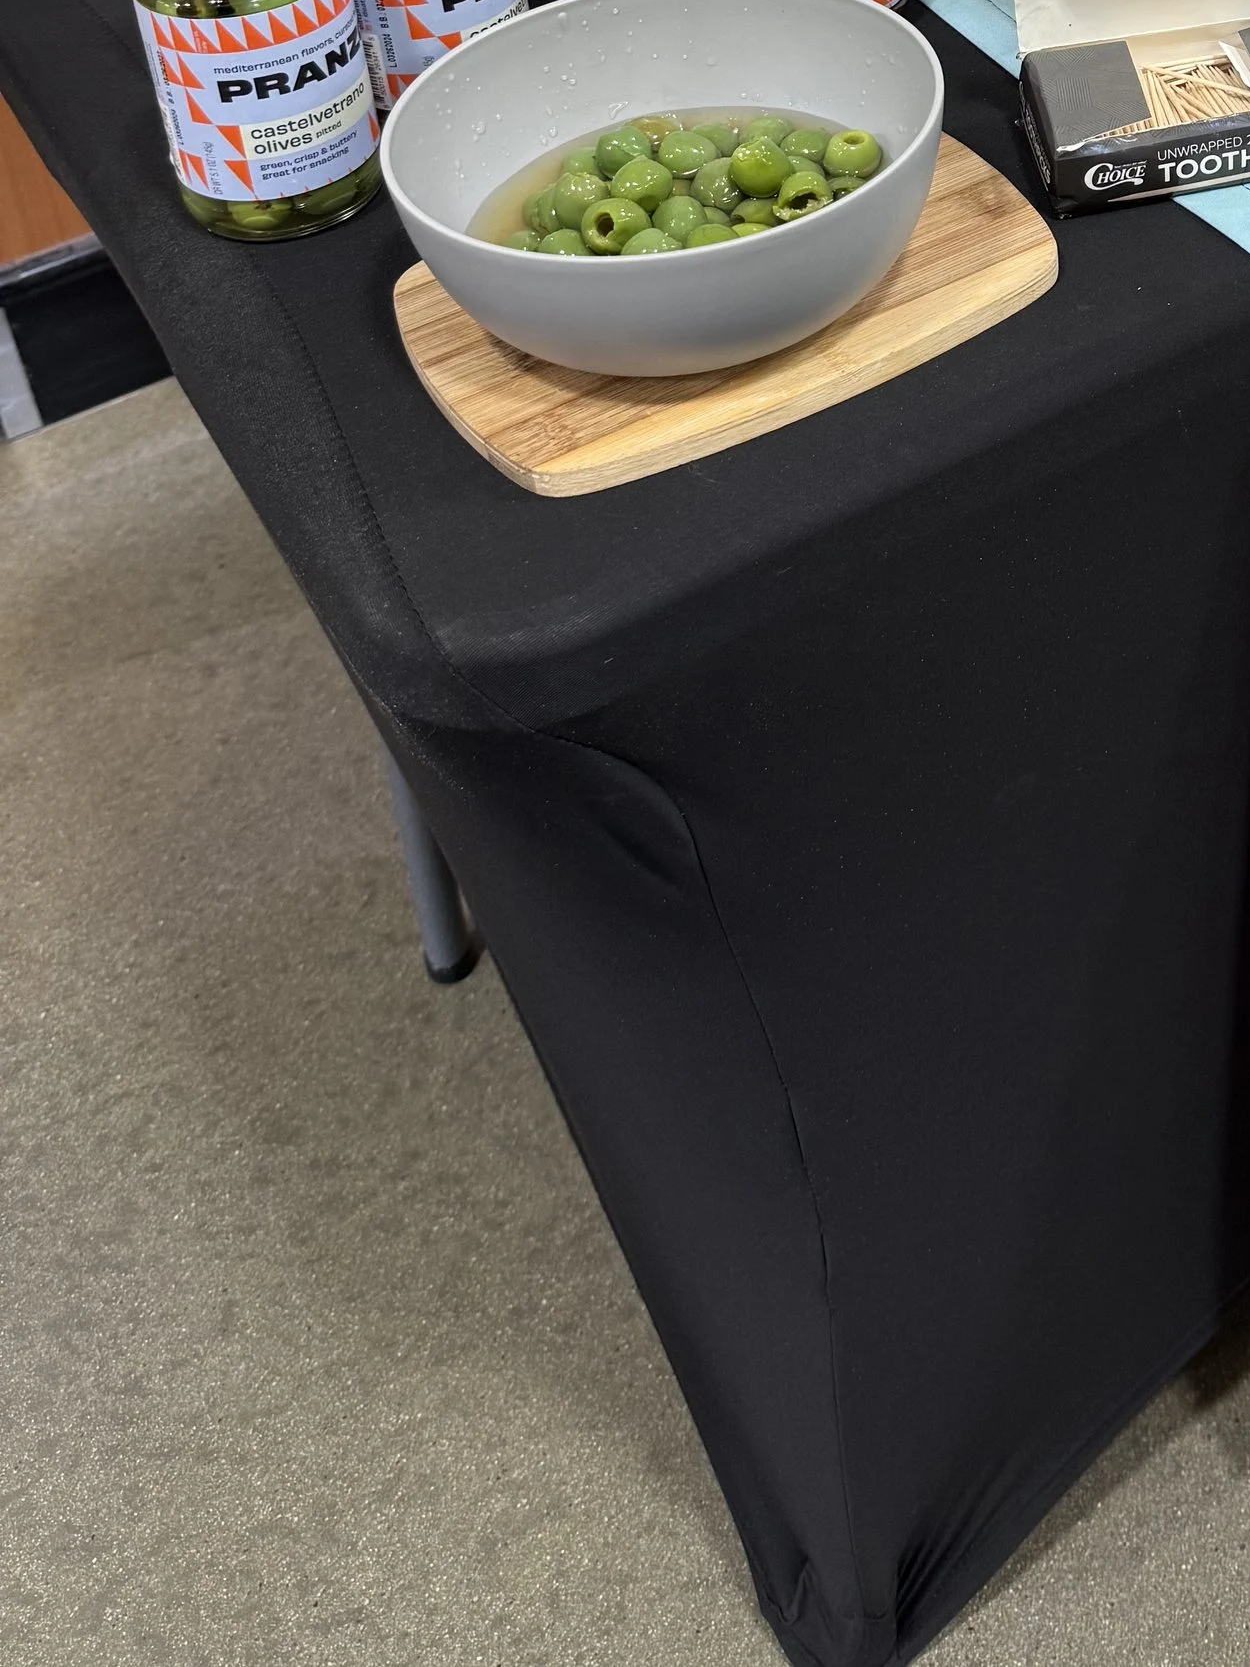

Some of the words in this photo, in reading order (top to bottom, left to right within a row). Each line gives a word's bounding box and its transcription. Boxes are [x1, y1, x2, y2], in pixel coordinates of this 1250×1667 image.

[251, 82, 364, 139] castelvetrano
[254, 134, 313, 154] olives
[316, 120, 341, 138] pitted
[1157, 136, 1242, 160] UNWRAPPED
[1084, 162, 1146, 191] CHOICE
